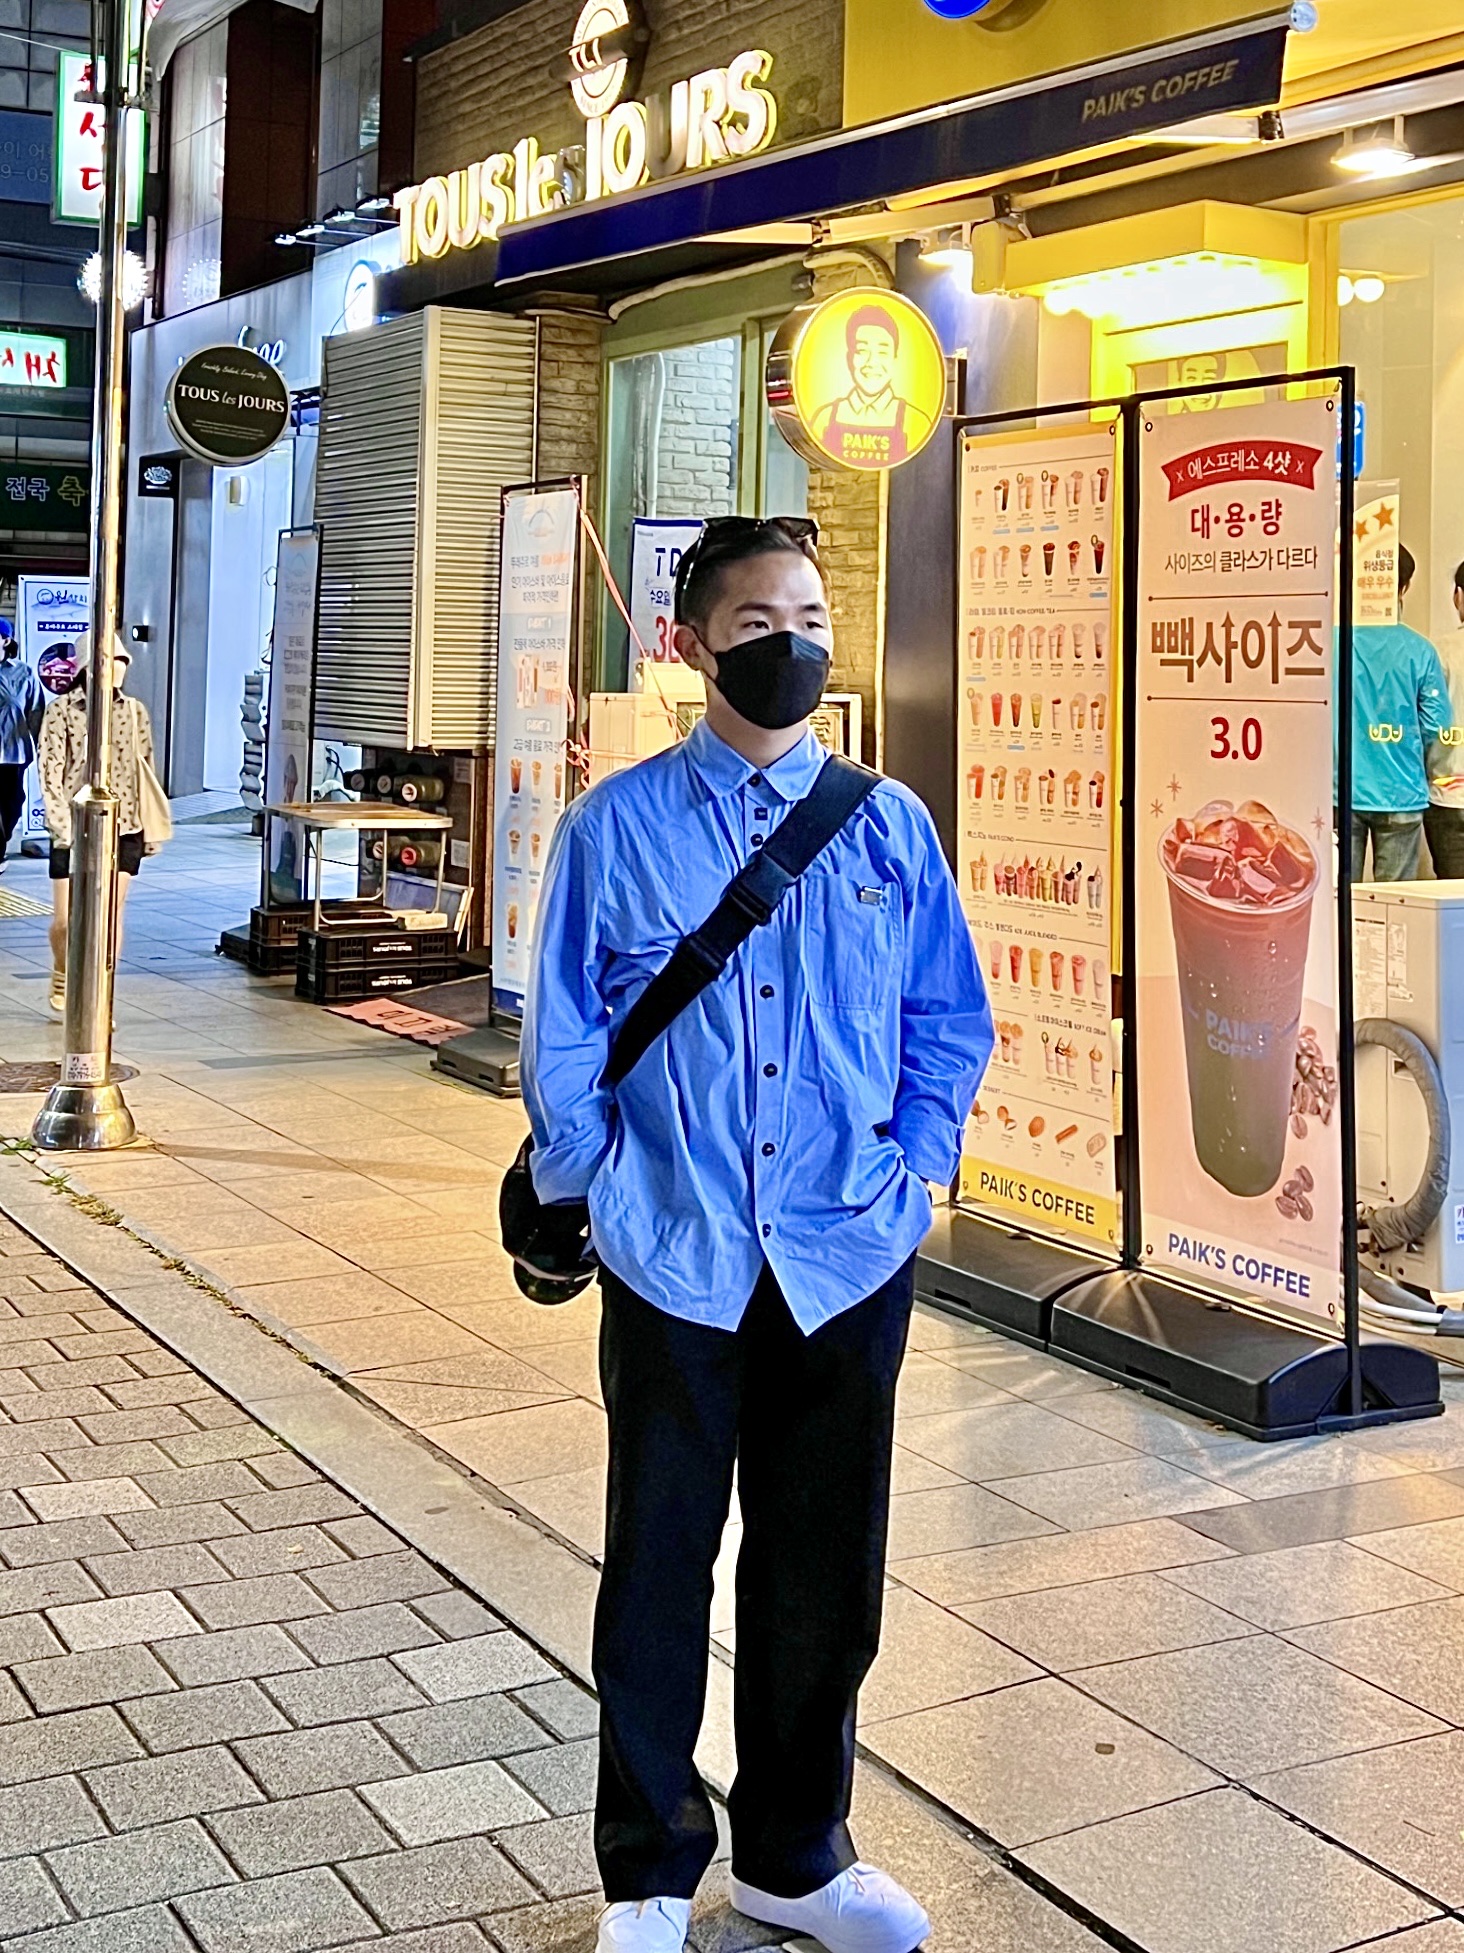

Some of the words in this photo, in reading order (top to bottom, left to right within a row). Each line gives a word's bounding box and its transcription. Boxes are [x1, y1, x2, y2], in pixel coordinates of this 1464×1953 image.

[1082, 85, 1145, 123] PAIK'S
[1151, 59, 1240, 107] COFFEE
[393, 153, 515, 265] TOUS
[178, 384, 219, 402] TOUS
[222, 391, 237, 404] les
[238, 394, 285, 413] JOURS
[843, 432, 890, 450] PAIK'S
[843, 450, 889, 461] COFFEE
[1187, 449, 1259, 479] 에스프레소
[1263, 450, 1291, 475] 4샷
[6, 476, 50, 502] 전국
[1191, 498, 1282, 540] 대·용·량
[1165, 551, 1217, 575] 사이즈의
[1219, 547, 1274, 573] 클라스가
[1277, 546, 1318, 570] 다르다
[1357, 576, 1375, 589] 매우
[1376, 575, 1394, 589] 우수
[1151, 611, 1326, 685] 빽사이즈
[1210, 716, 1263, 761] 3.0
[1205, 1008, 1273, 1041] PAI
[980, 1171, 1028, 1203] PAIK'S
[1032, 1188, 1096, 1225] COFFEE
[1168, 1232, 1226, 1270] PAIK'S
[1232, 1254, 1311, 1298] COFFEE
